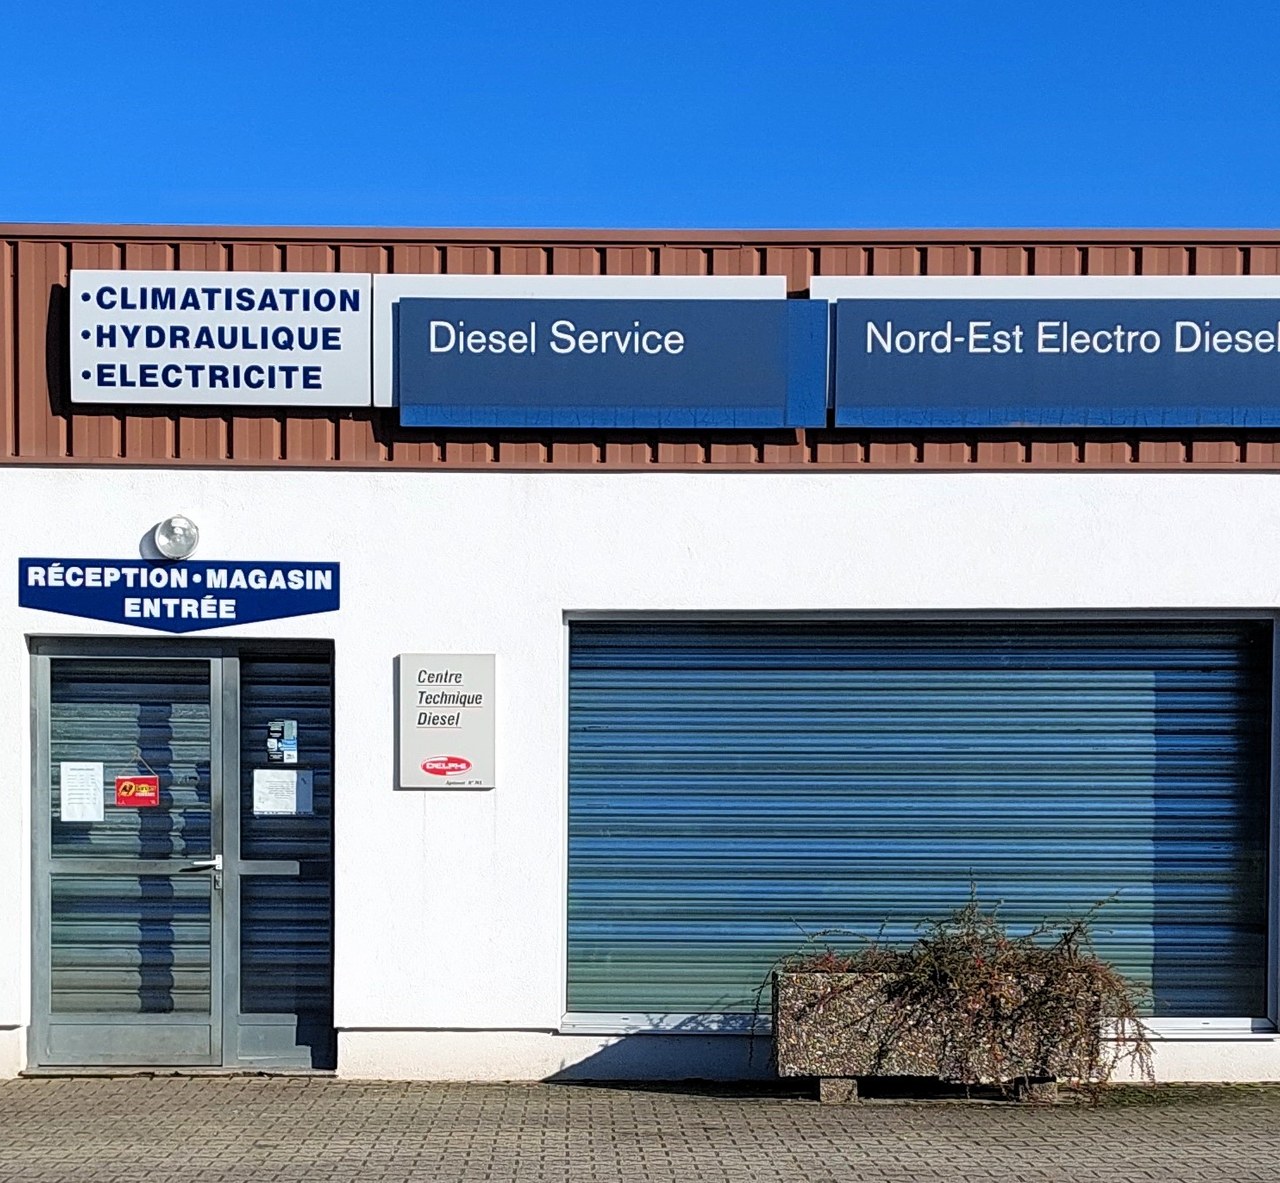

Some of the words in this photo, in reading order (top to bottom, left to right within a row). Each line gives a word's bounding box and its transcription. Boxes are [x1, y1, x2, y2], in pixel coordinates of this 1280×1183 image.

[95, 286, 360, 312] CLIMATISATION
[96, 324, 342, 351] HYDRAULIQUE
[429, 320, 536, 354] Diesel
[549, 320, 686, 355] Service
[865, 320, 1024, 354] Nord-Est
[1037, 320, 1161, 354] Electro
[96, 363, 322, 390] ELECTRICITE
[124, 595, 236, 619] ENTRÉE
[417, 669, 463, 684] Centre
[418, 691, 483, 707] Technique
[417, 712, 461, 726] Diesel
